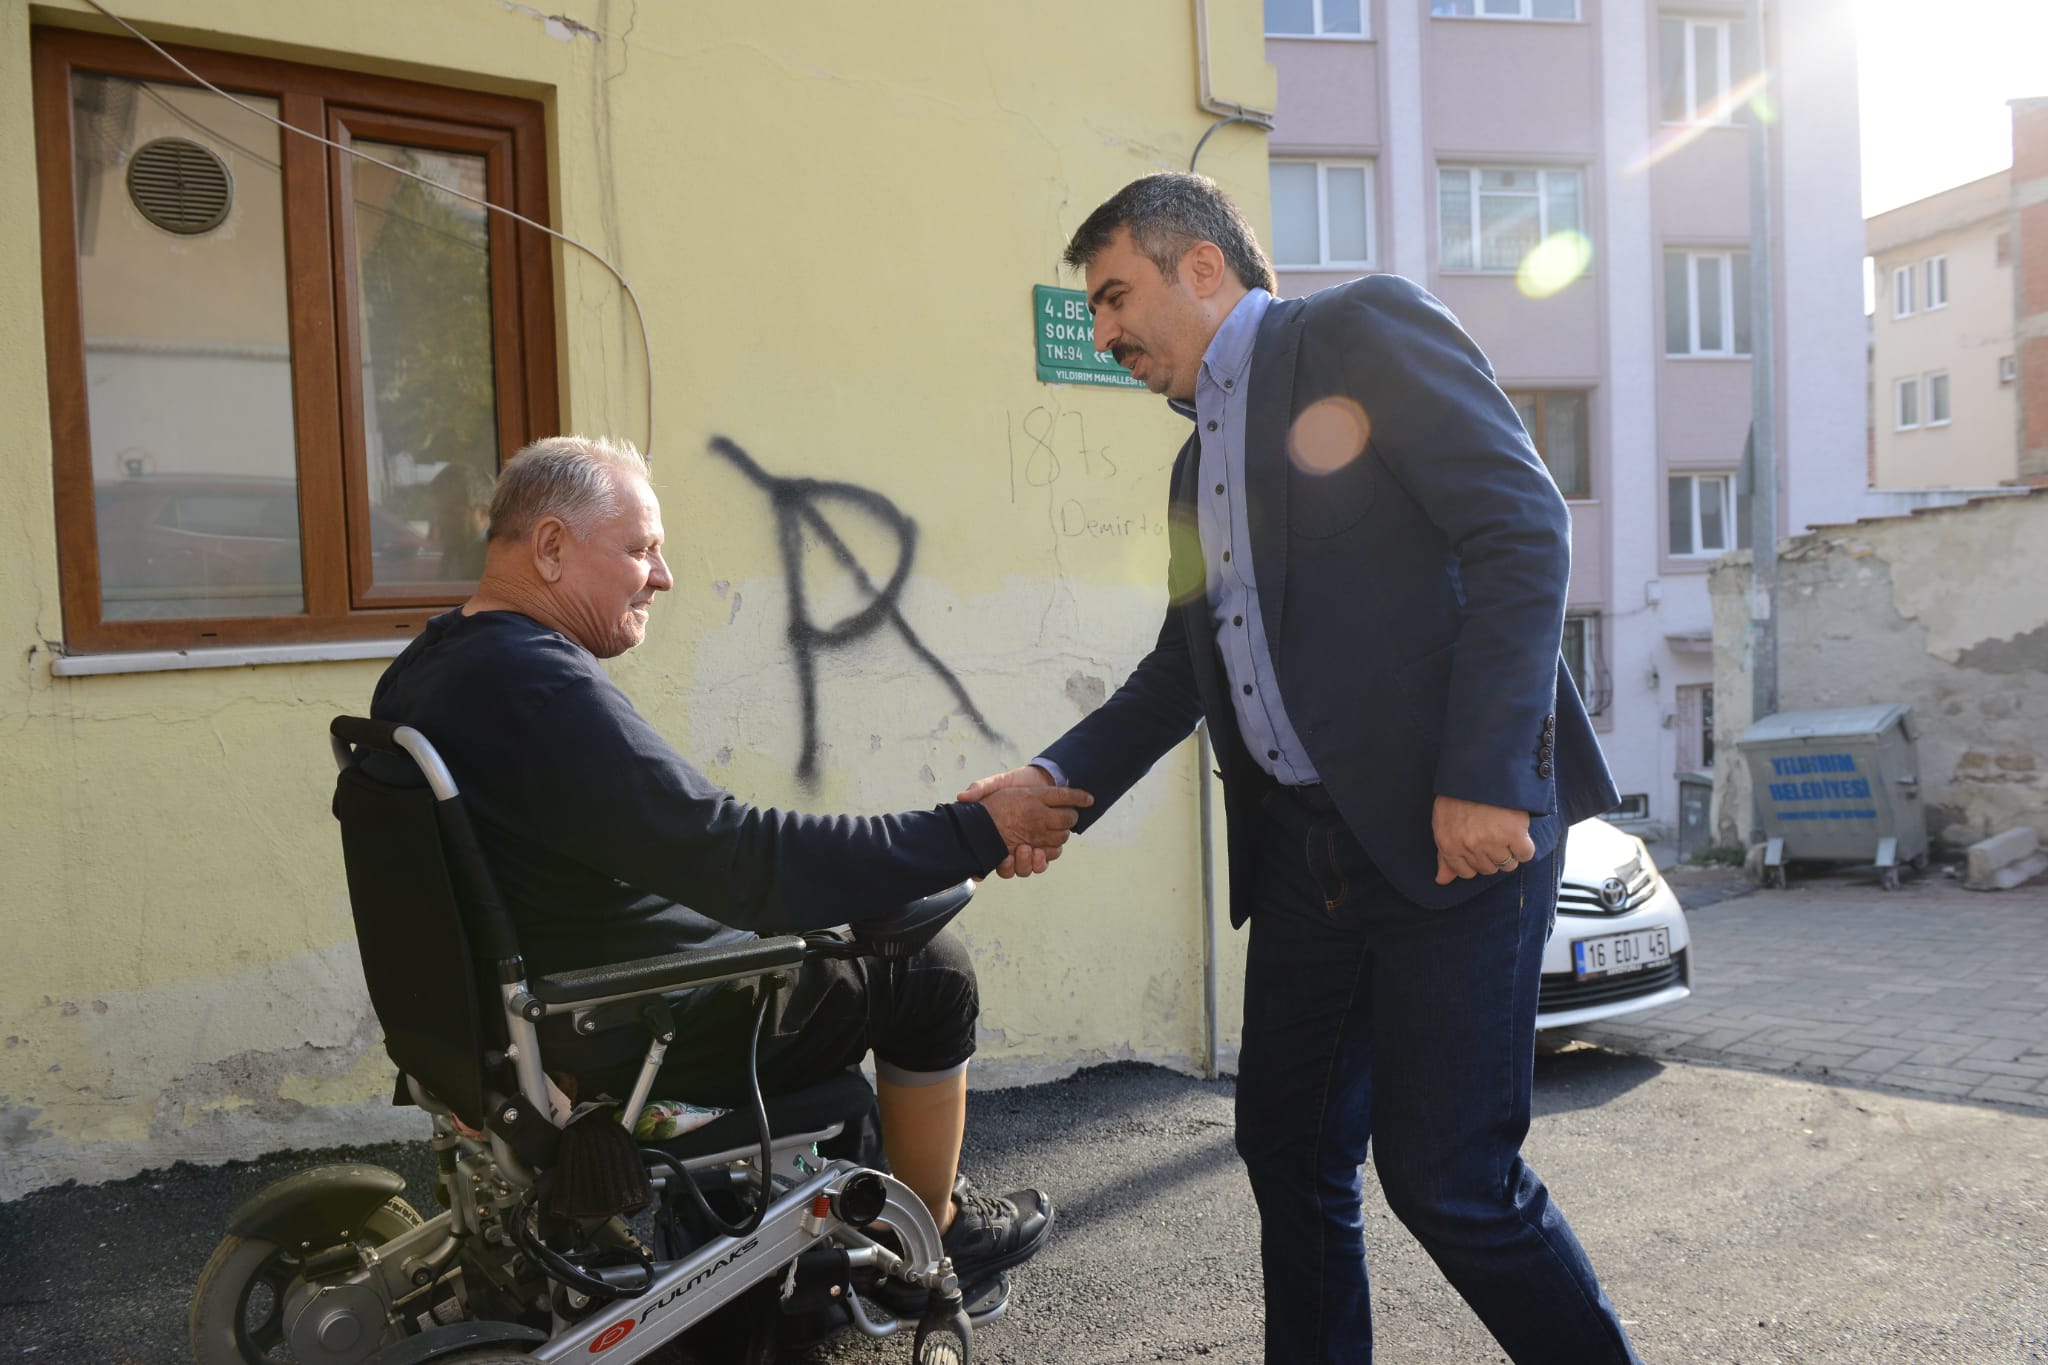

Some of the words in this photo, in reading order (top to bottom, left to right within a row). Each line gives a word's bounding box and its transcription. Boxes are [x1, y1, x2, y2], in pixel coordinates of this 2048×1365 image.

[1046, 323, 1094, 341] SOKAK
[1046, 344, 1083, 360] TN:94
[1056, 370, 1092, 381] YILDIRIM
[1589, 943, 1605, 968] 16
[1615, 938, 1639, 963] EDJ
[1649, 933, 1665, 957] 45
